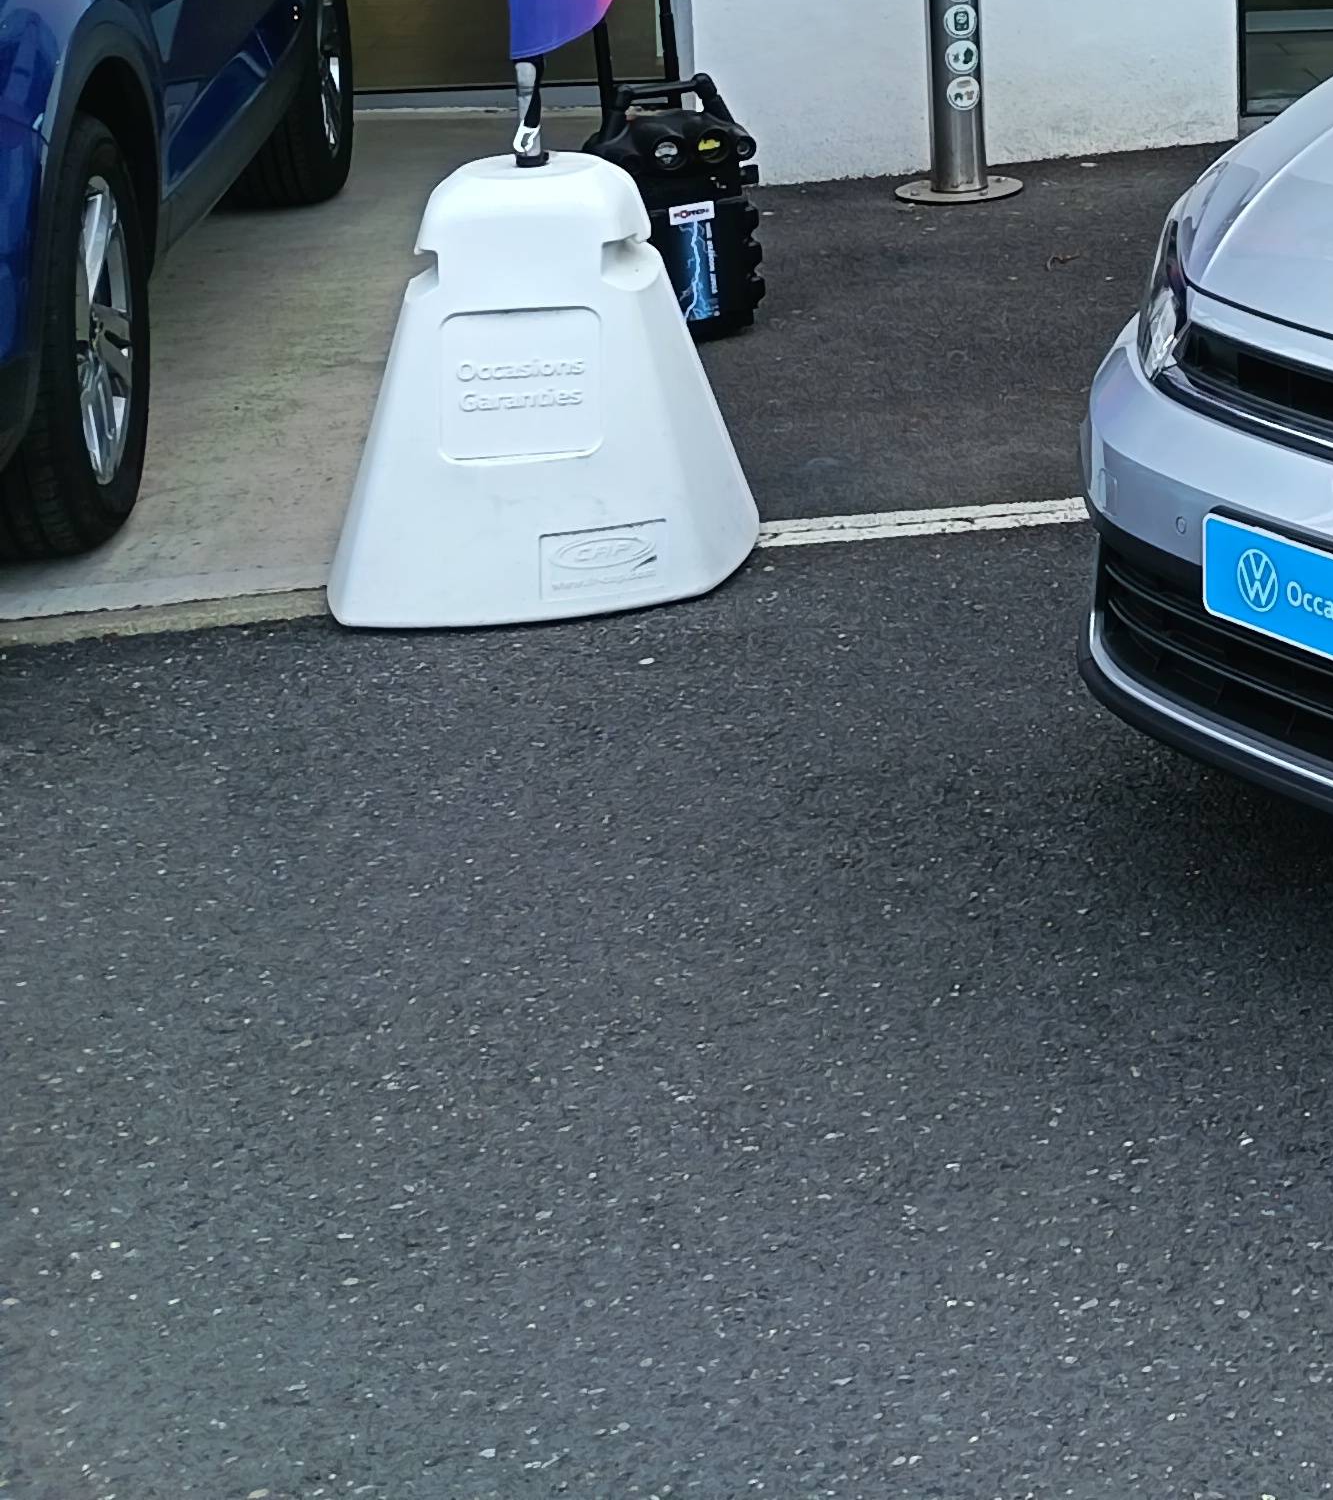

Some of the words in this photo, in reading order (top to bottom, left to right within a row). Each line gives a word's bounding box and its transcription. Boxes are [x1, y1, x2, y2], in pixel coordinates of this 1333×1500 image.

[456, 356, 586, 383] Occasions
[459, 388, 583, 413] Garanties
[1236, 548, 1278, 613] VW
